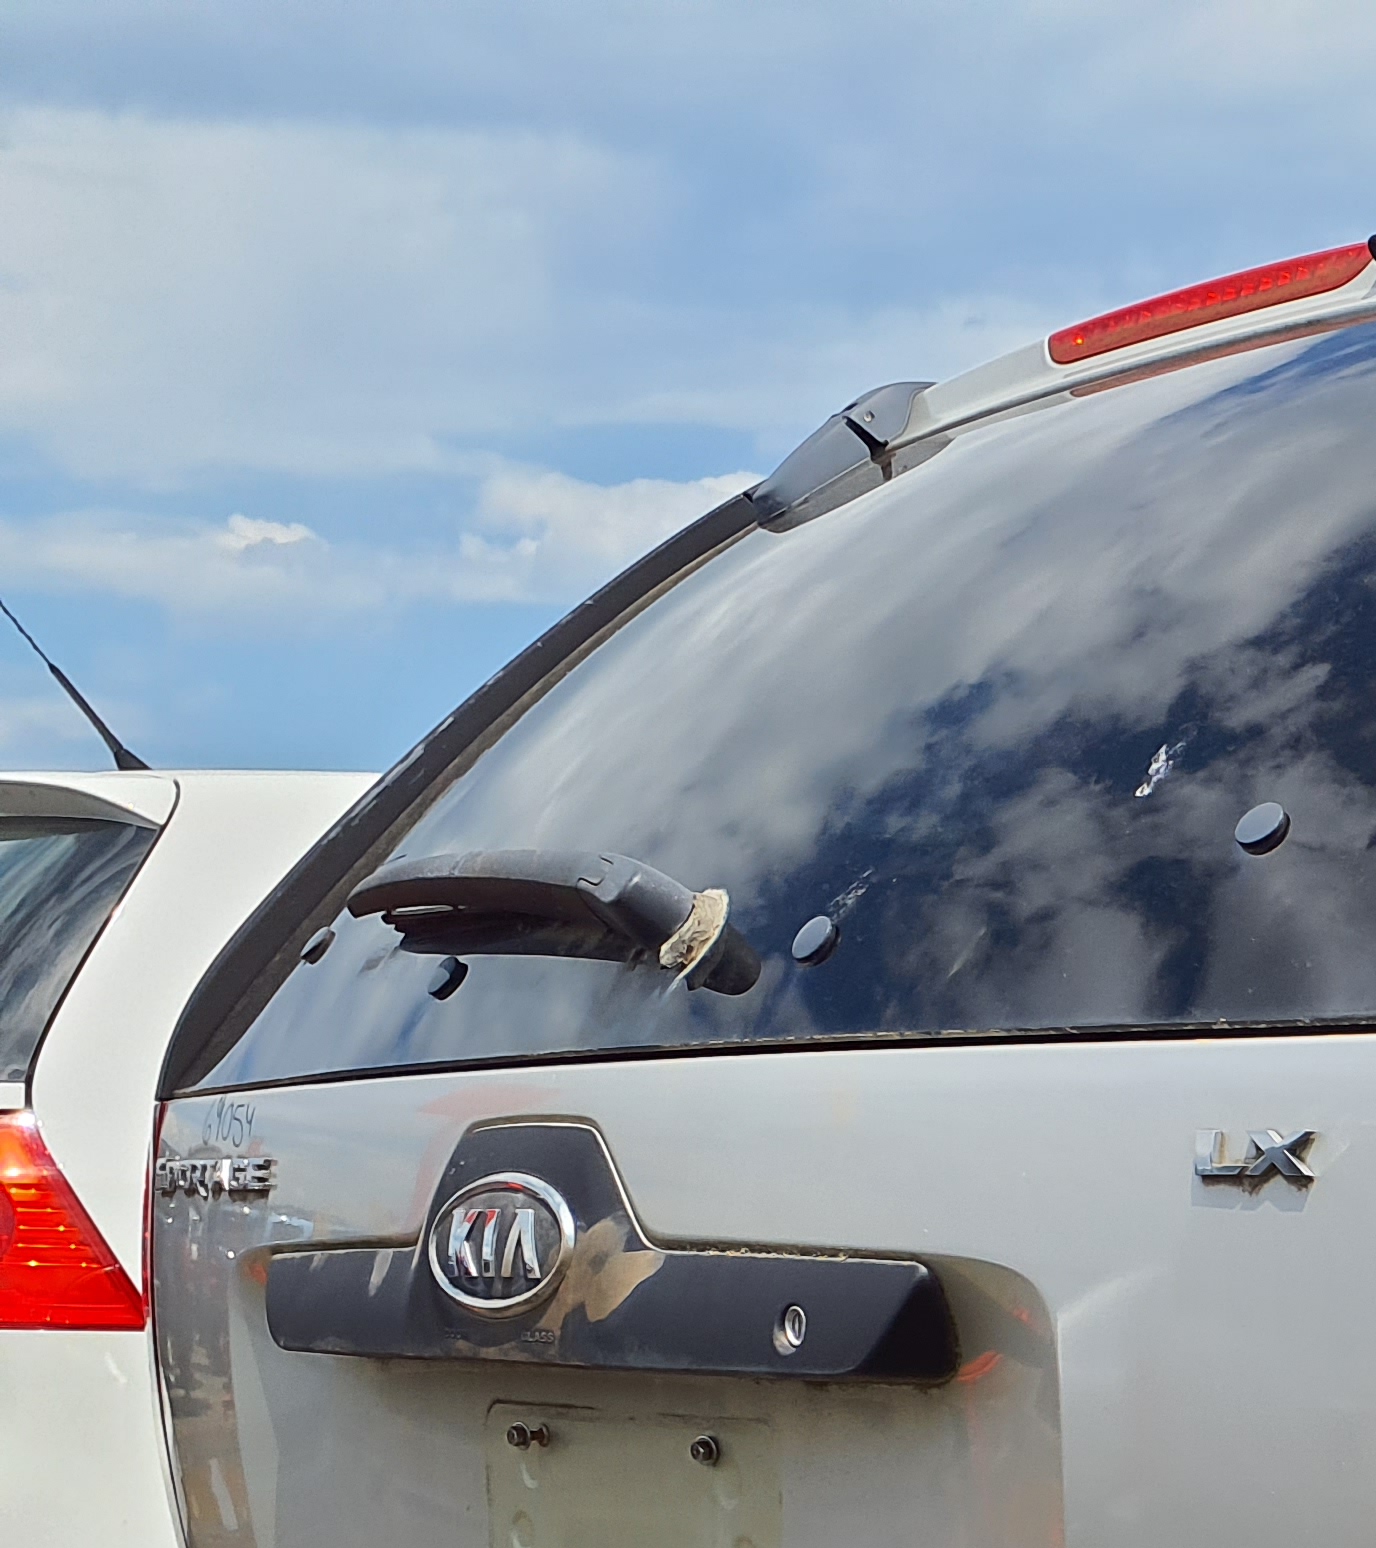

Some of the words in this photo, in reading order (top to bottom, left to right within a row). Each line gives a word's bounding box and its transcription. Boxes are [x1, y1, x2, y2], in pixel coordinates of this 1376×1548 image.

[201, 1093, 257, 1148] 69054
[1195, 1128, 1318, 1178] LX
[447, 1208, 542, 1279] KIA
